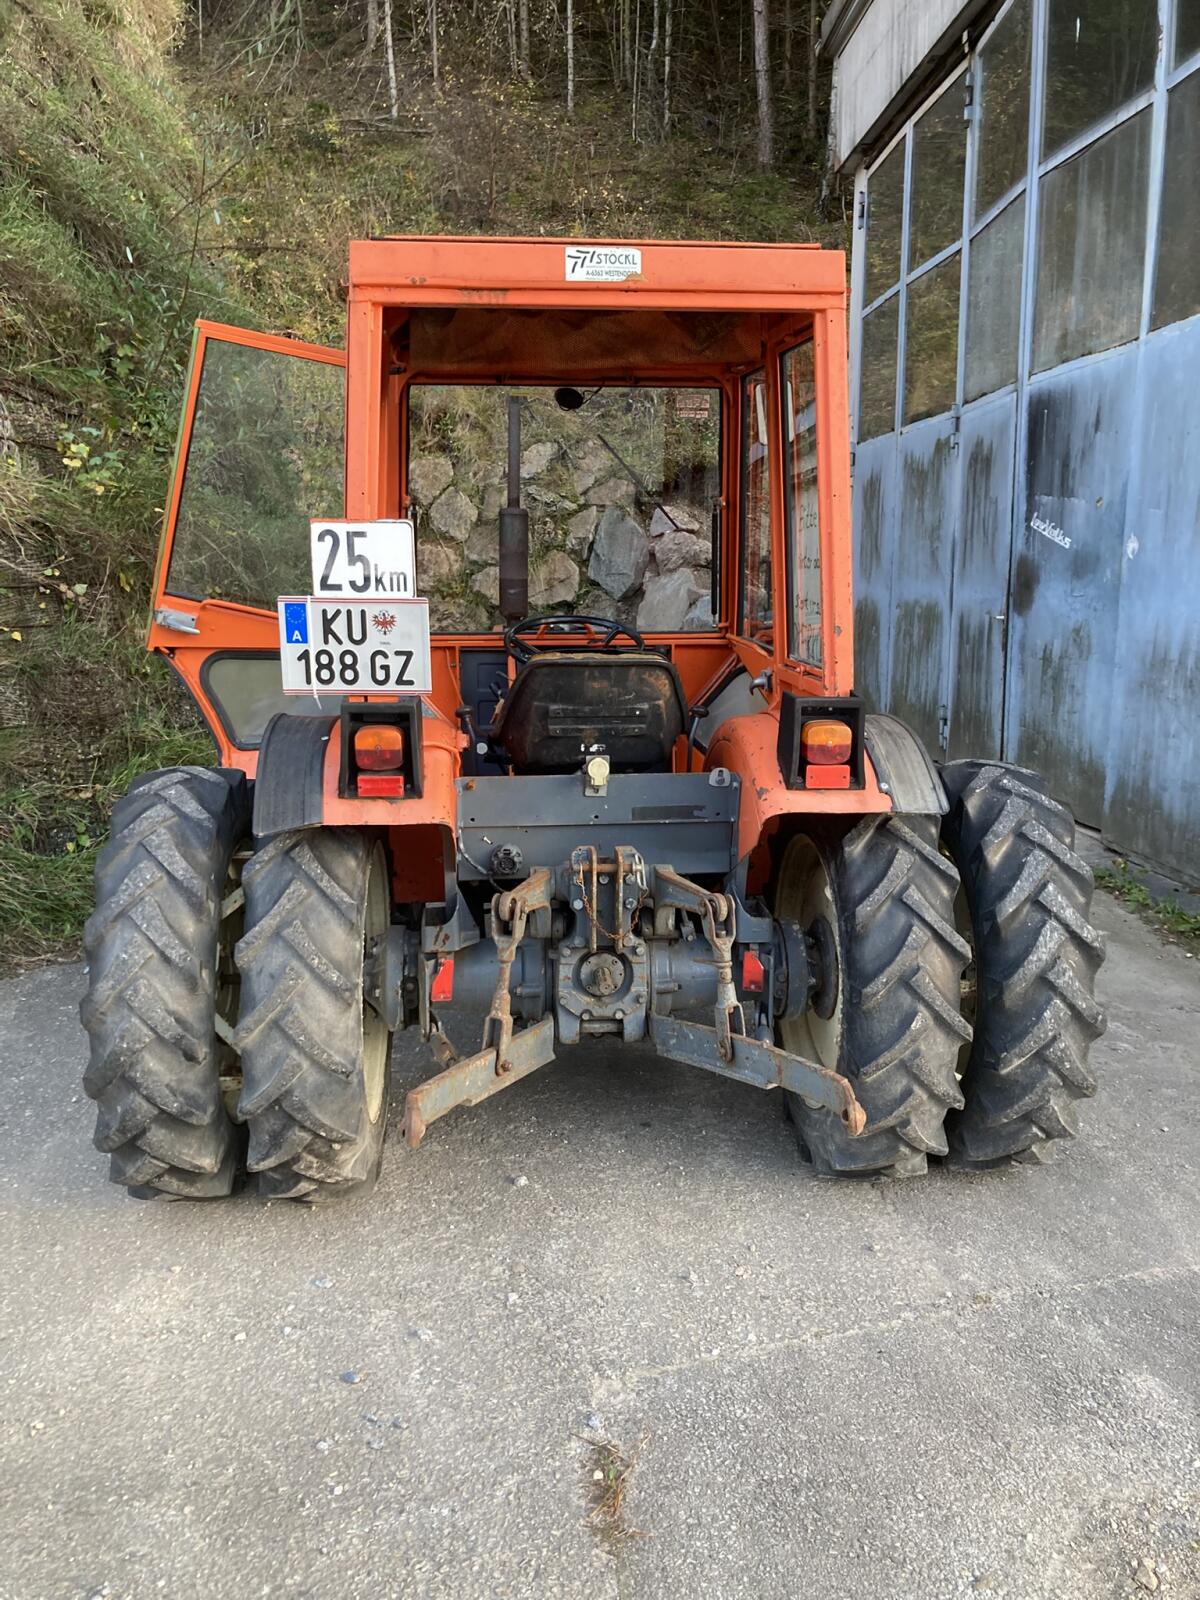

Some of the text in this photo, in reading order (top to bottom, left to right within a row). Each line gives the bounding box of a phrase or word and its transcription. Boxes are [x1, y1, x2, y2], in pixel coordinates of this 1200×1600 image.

[291, 630, 303, 642] A
[321, 608, 368, 646] KU
[297, 649, 415, 686] 188 GZ
